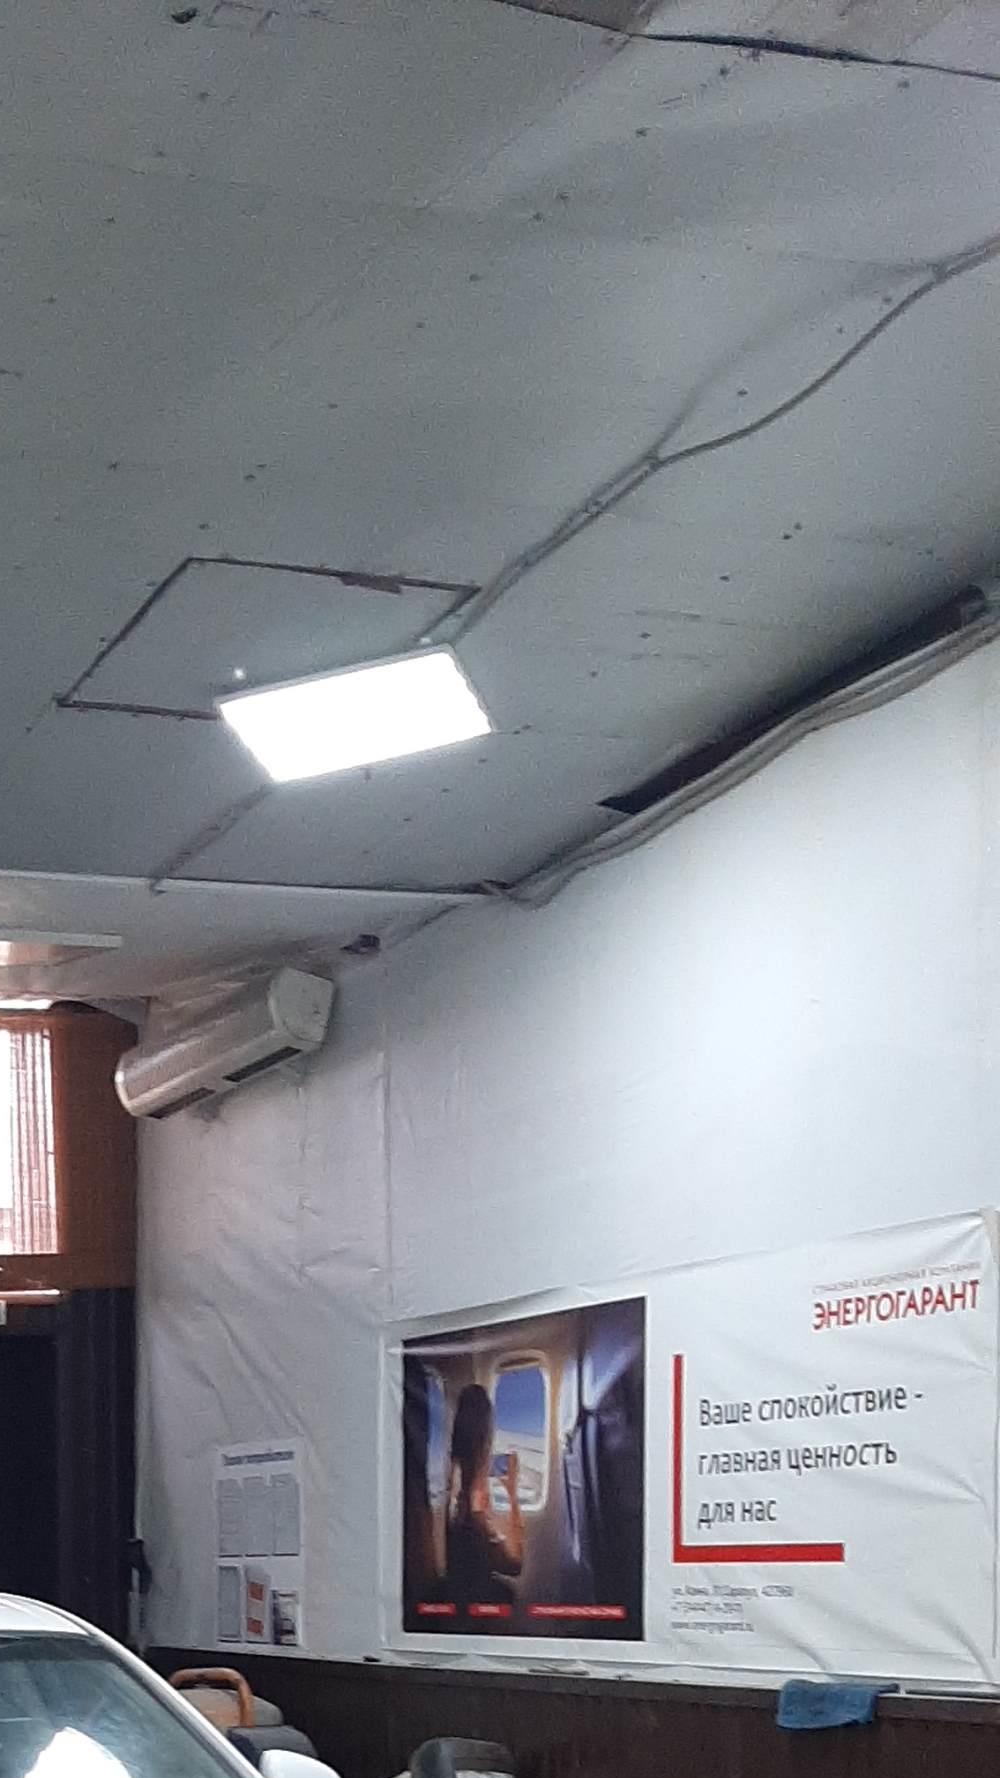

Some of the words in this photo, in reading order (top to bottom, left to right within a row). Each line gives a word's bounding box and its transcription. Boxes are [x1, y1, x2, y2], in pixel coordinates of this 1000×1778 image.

[813, 1279, 980, 1330] ЭНЕРГОГАРАНТ
[700, 1398, 752, 1427] Ваше
[758, 1383, 908, 1422] спокойствие
[698, 1449, 782, 1476] главная
[786, 1442, 898, 1476] ценность
[698, 1501, 736, 1530] для
[740, 1499, 777, 1522] нас
